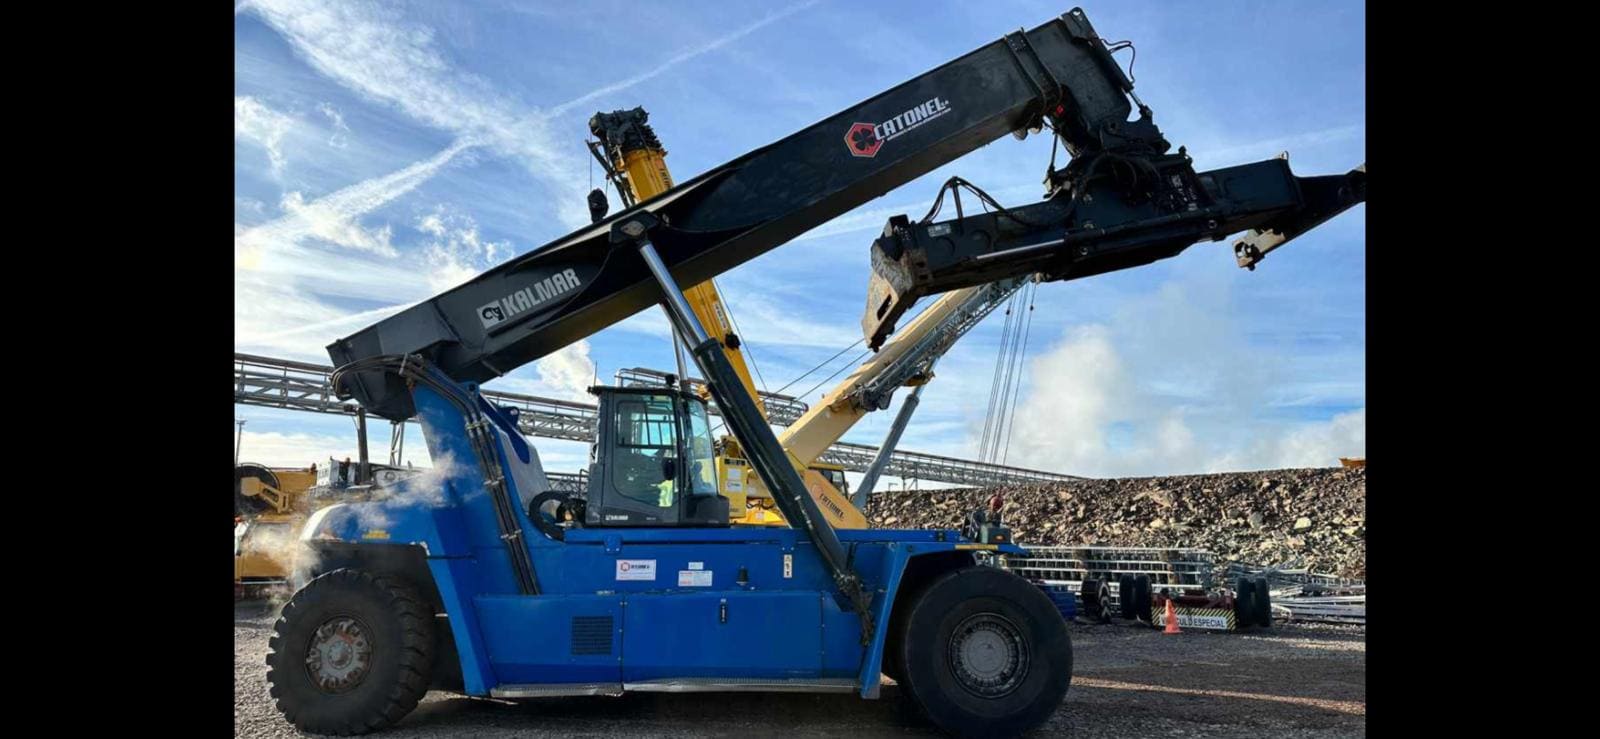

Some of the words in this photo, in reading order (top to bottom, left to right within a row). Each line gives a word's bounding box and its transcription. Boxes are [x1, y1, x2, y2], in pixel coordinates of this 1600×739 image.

[873, 97, 946, 141] CATONEL
[502, 268, 581, 316] KALMAR
[1194, 617, 1226, 628] ESPECIAL
